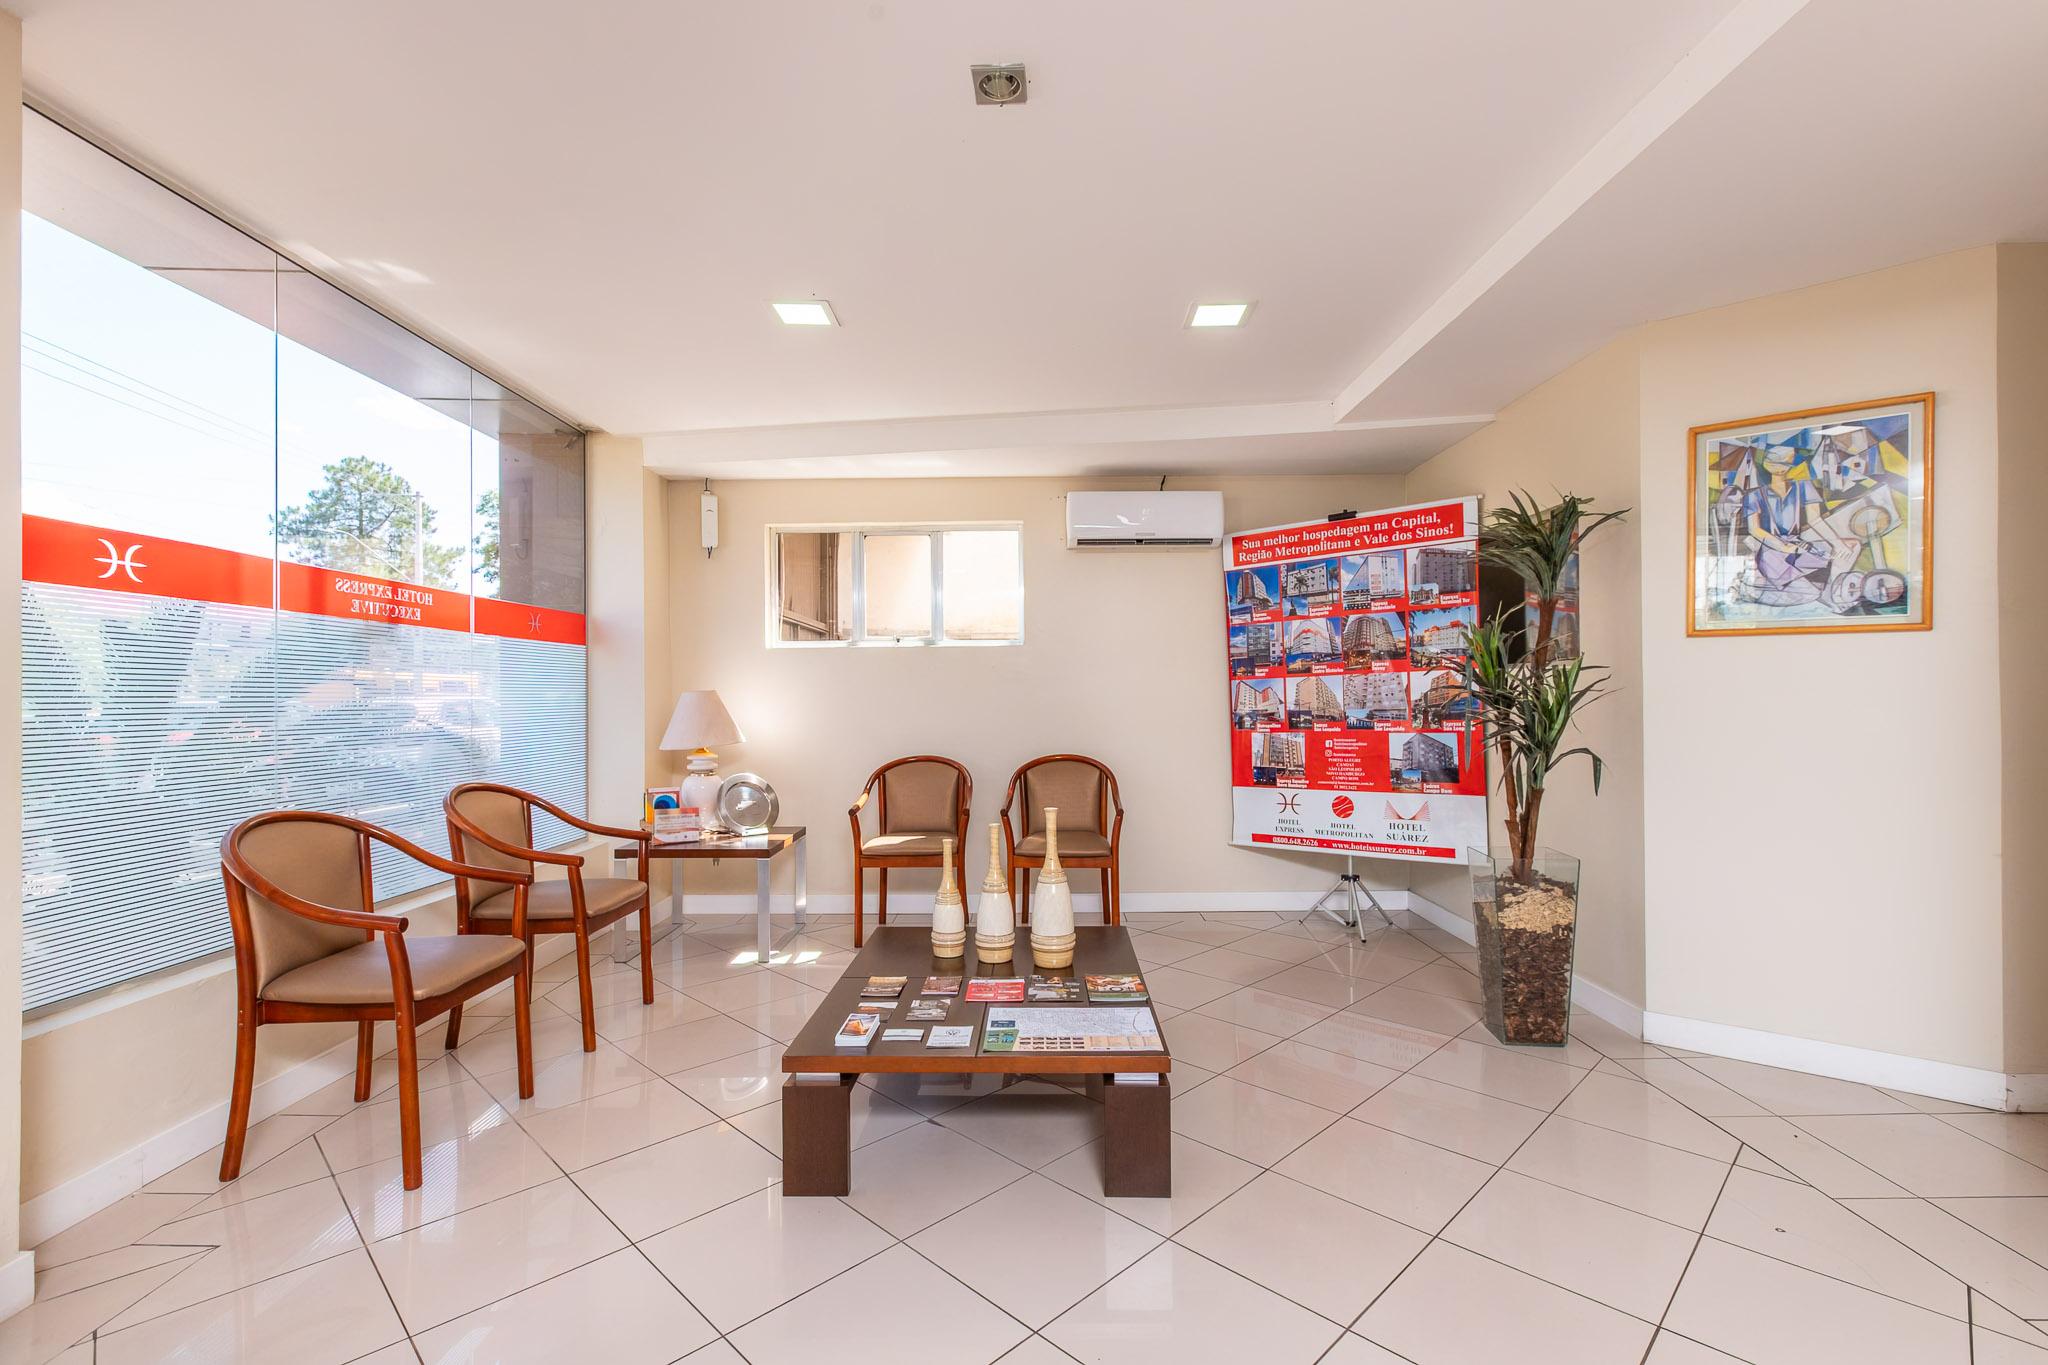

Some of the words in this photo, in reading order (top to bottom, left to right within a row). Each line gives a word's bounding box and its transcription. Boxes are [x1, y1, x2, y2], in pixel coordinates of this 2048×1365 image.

[1242, 539, 1260, 550] Sua
[1264, 534, 1300, 547] melhor
[1303, 524, 1370, 541] hospedagem
[1374, 521, 1388, 530] na
[1392, 512, 1441, 529] Capital,
[1239, 550, 1272, 562] Região
[1275, 537, 1350, 557] Metropolitana
[1354, 538, 1360, 546] e
[1364, 533, 1389, 545] Vale
[1392, 531, 1412, 541] dos
[1416, 523, 1454, 539] Sinos!
[1278, 818, 1301, 826] HOTEL
[1330, 822, 1356, 830] HOTEL
[1389, 822, 1426, 832] HOTEL
[1315, 829, 1374, 839] METROPOLITAN
[1386, 832, 1429, 843] SUÁREZ
